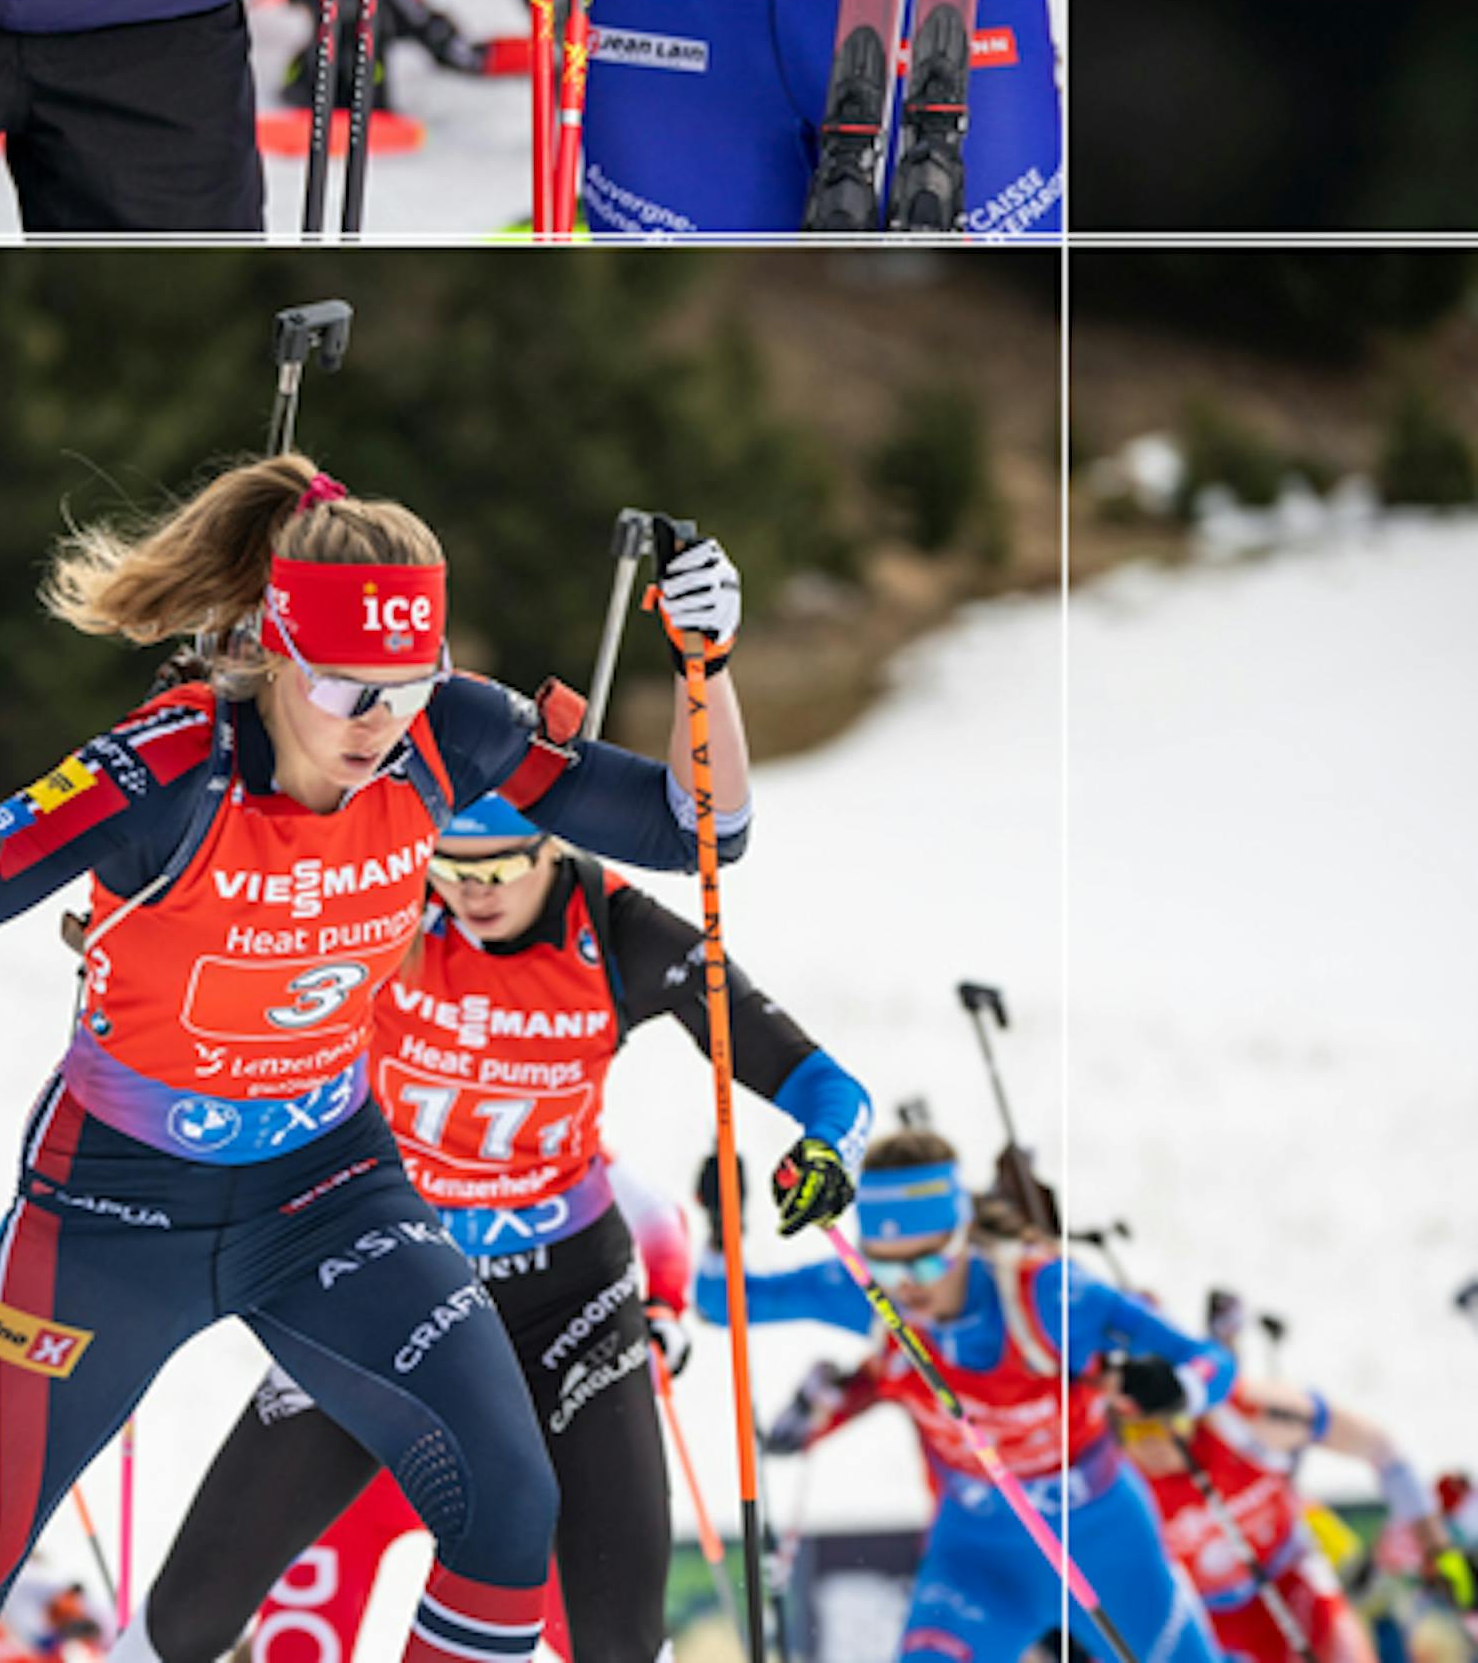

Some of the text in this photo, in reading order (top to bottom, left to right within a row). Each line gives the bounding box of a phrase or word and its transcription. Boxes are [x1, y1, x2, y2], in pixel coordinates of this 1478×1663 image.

[967, 165, 1047, 234] CAISSE
[361, 580, 432, 632] ice
[213, 834, 436, 920] VIESSMANN
[226, 900, 423, 956] Heat pumps
[265, 961, 369, 1028] 3
[391, 981, 612, 1050] VIESSMANN
[399, 1034, 584, 1089] Heat pumps
[393, 1280, 483, 1374] CRAFT
